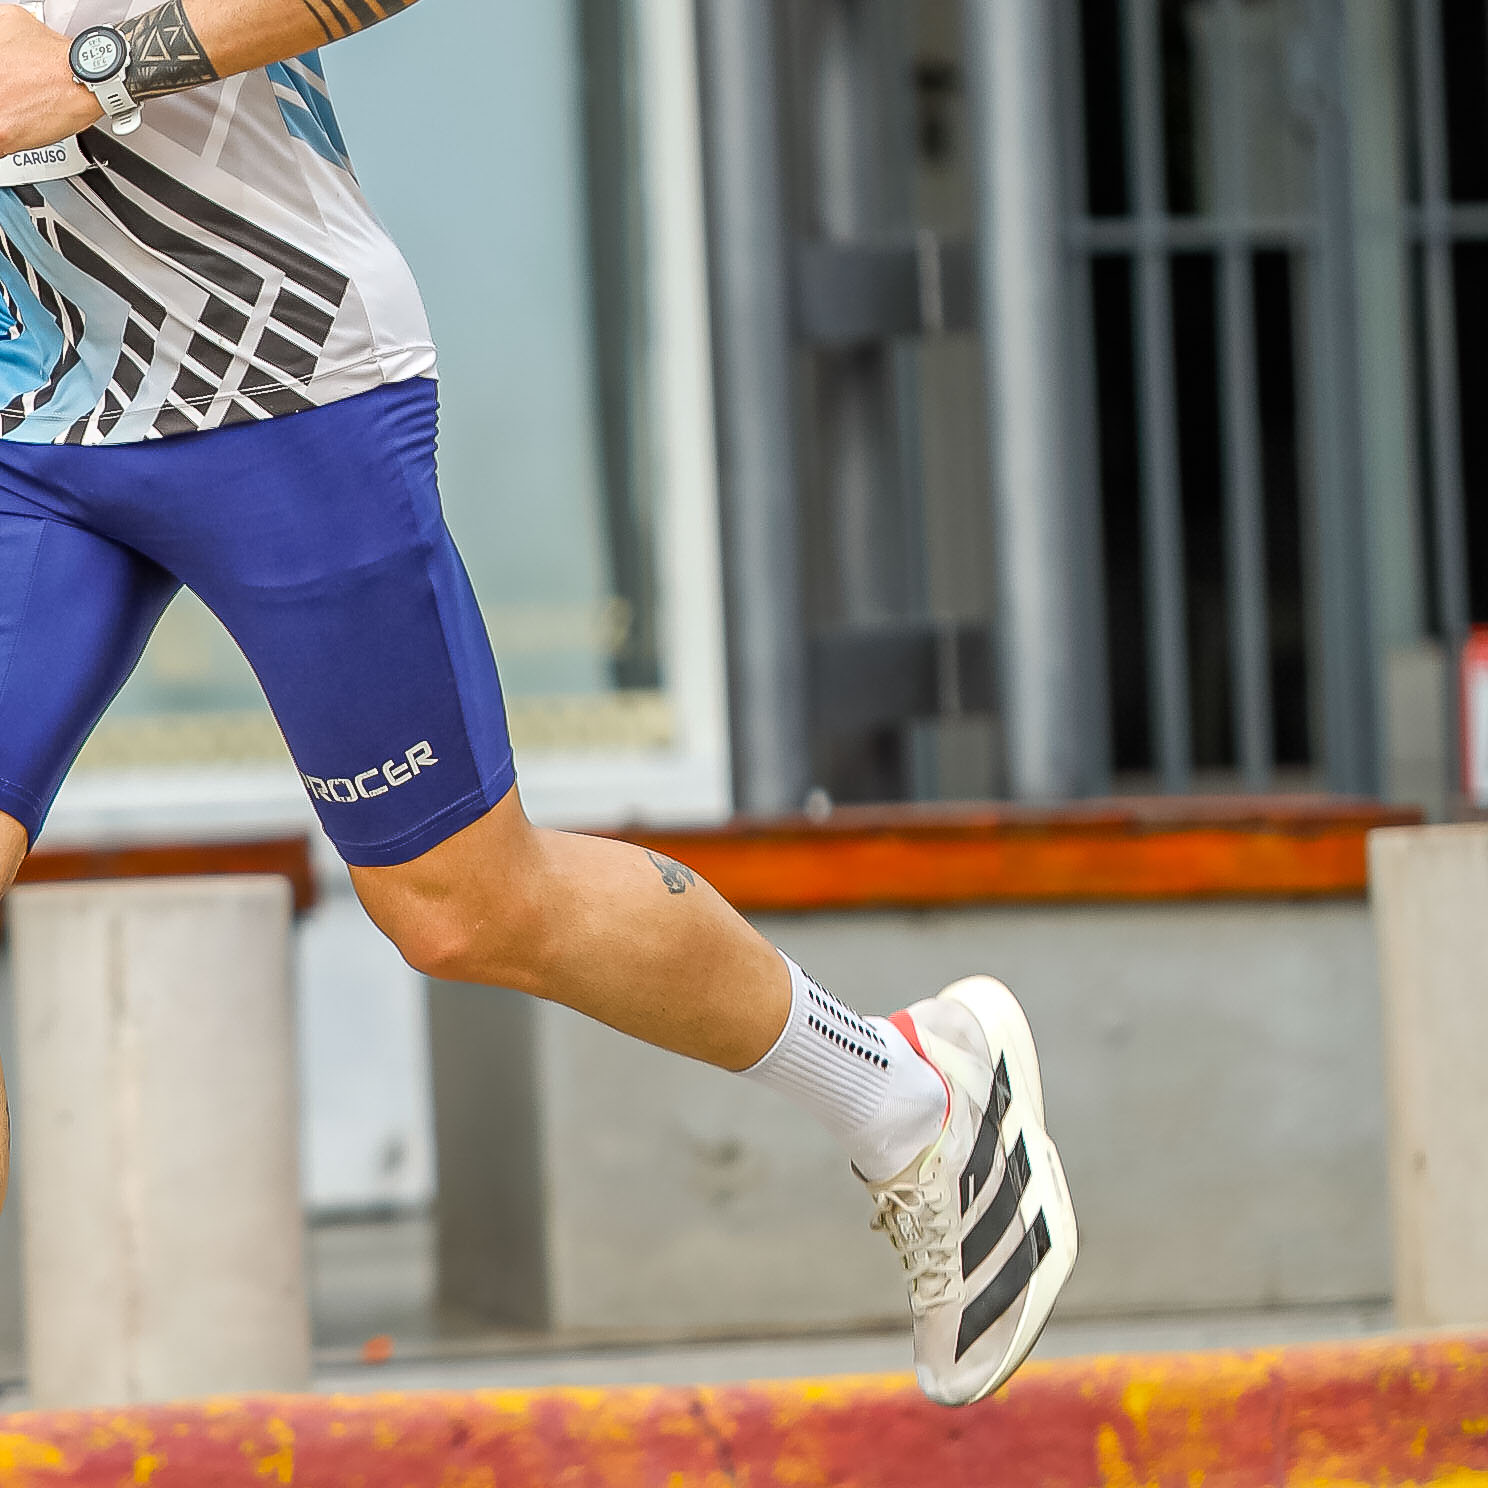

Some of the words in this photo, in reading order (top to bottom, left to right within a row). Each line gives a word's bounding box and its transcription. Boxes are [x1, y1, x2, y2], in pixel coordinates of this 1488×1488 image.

[81, 43, 113, 62] 36:15
[12, 149, 67, 167] CARUSO
[302, 740, 439, 804] ROCER
